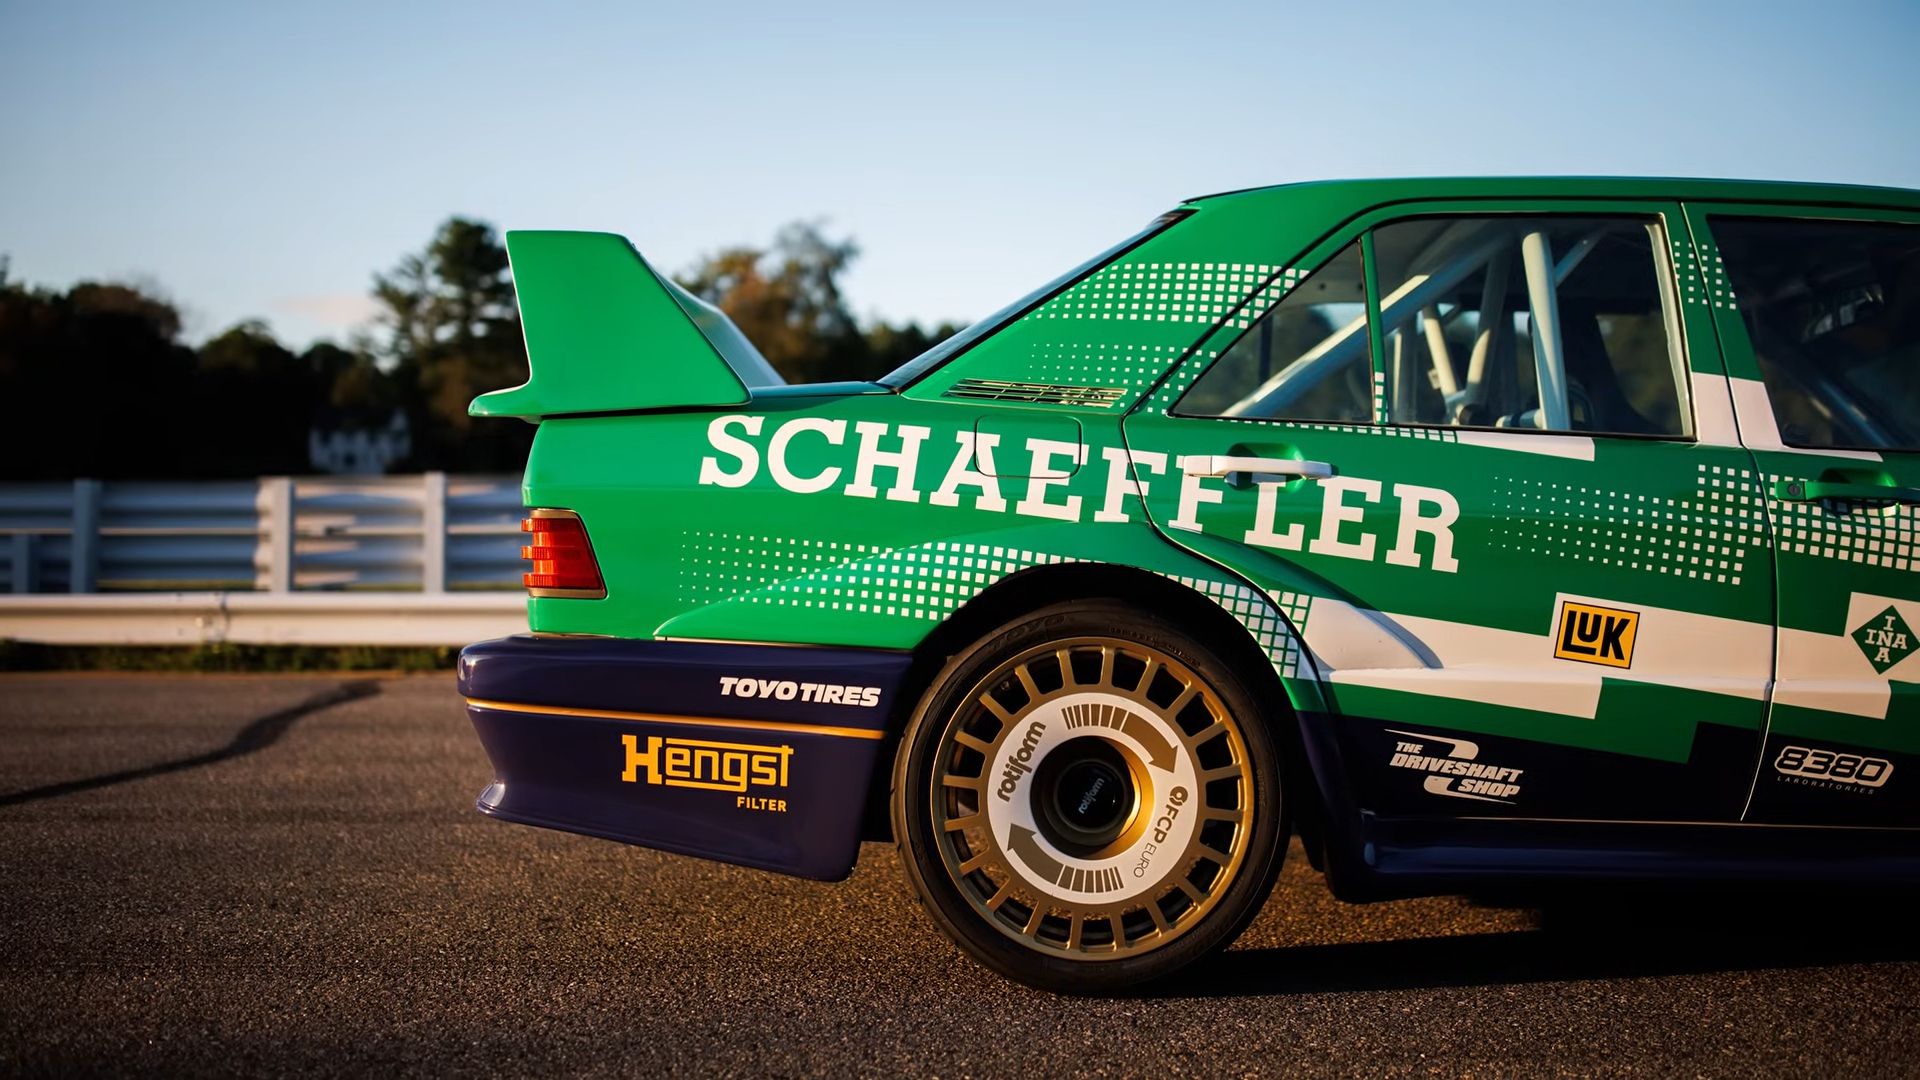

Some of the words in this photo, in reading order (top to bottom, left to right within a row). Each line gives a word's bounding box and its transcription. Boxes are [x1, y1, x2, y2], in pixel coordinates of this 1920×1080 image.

[699, 415, 1460, 573] SCHAEFFLER
[1864, 628, 1907, 650] INA
[720, 676, 798, 700] TOYO
[800, 682, 881, 707] TIRES
[622, 734, 794, 792] Hengst
[997, 721, 1047, 802] rotiform
[1395, 741, 1423, 754] THE
[1389, 753, 1524, 782] DRIVESHAFT
[1774, 745, 1894, 787] 8380
[1078, 778, 1105, 814] rotiform
[1458, 778, 1520, 797] SHOP
[1777, 775, 1875, 795] LABORATORIES
[737, 796, 787, 812] FILTER
[1154, 804, 1179, 844] FCP
[1133, 842, 1157, 878] EURO
